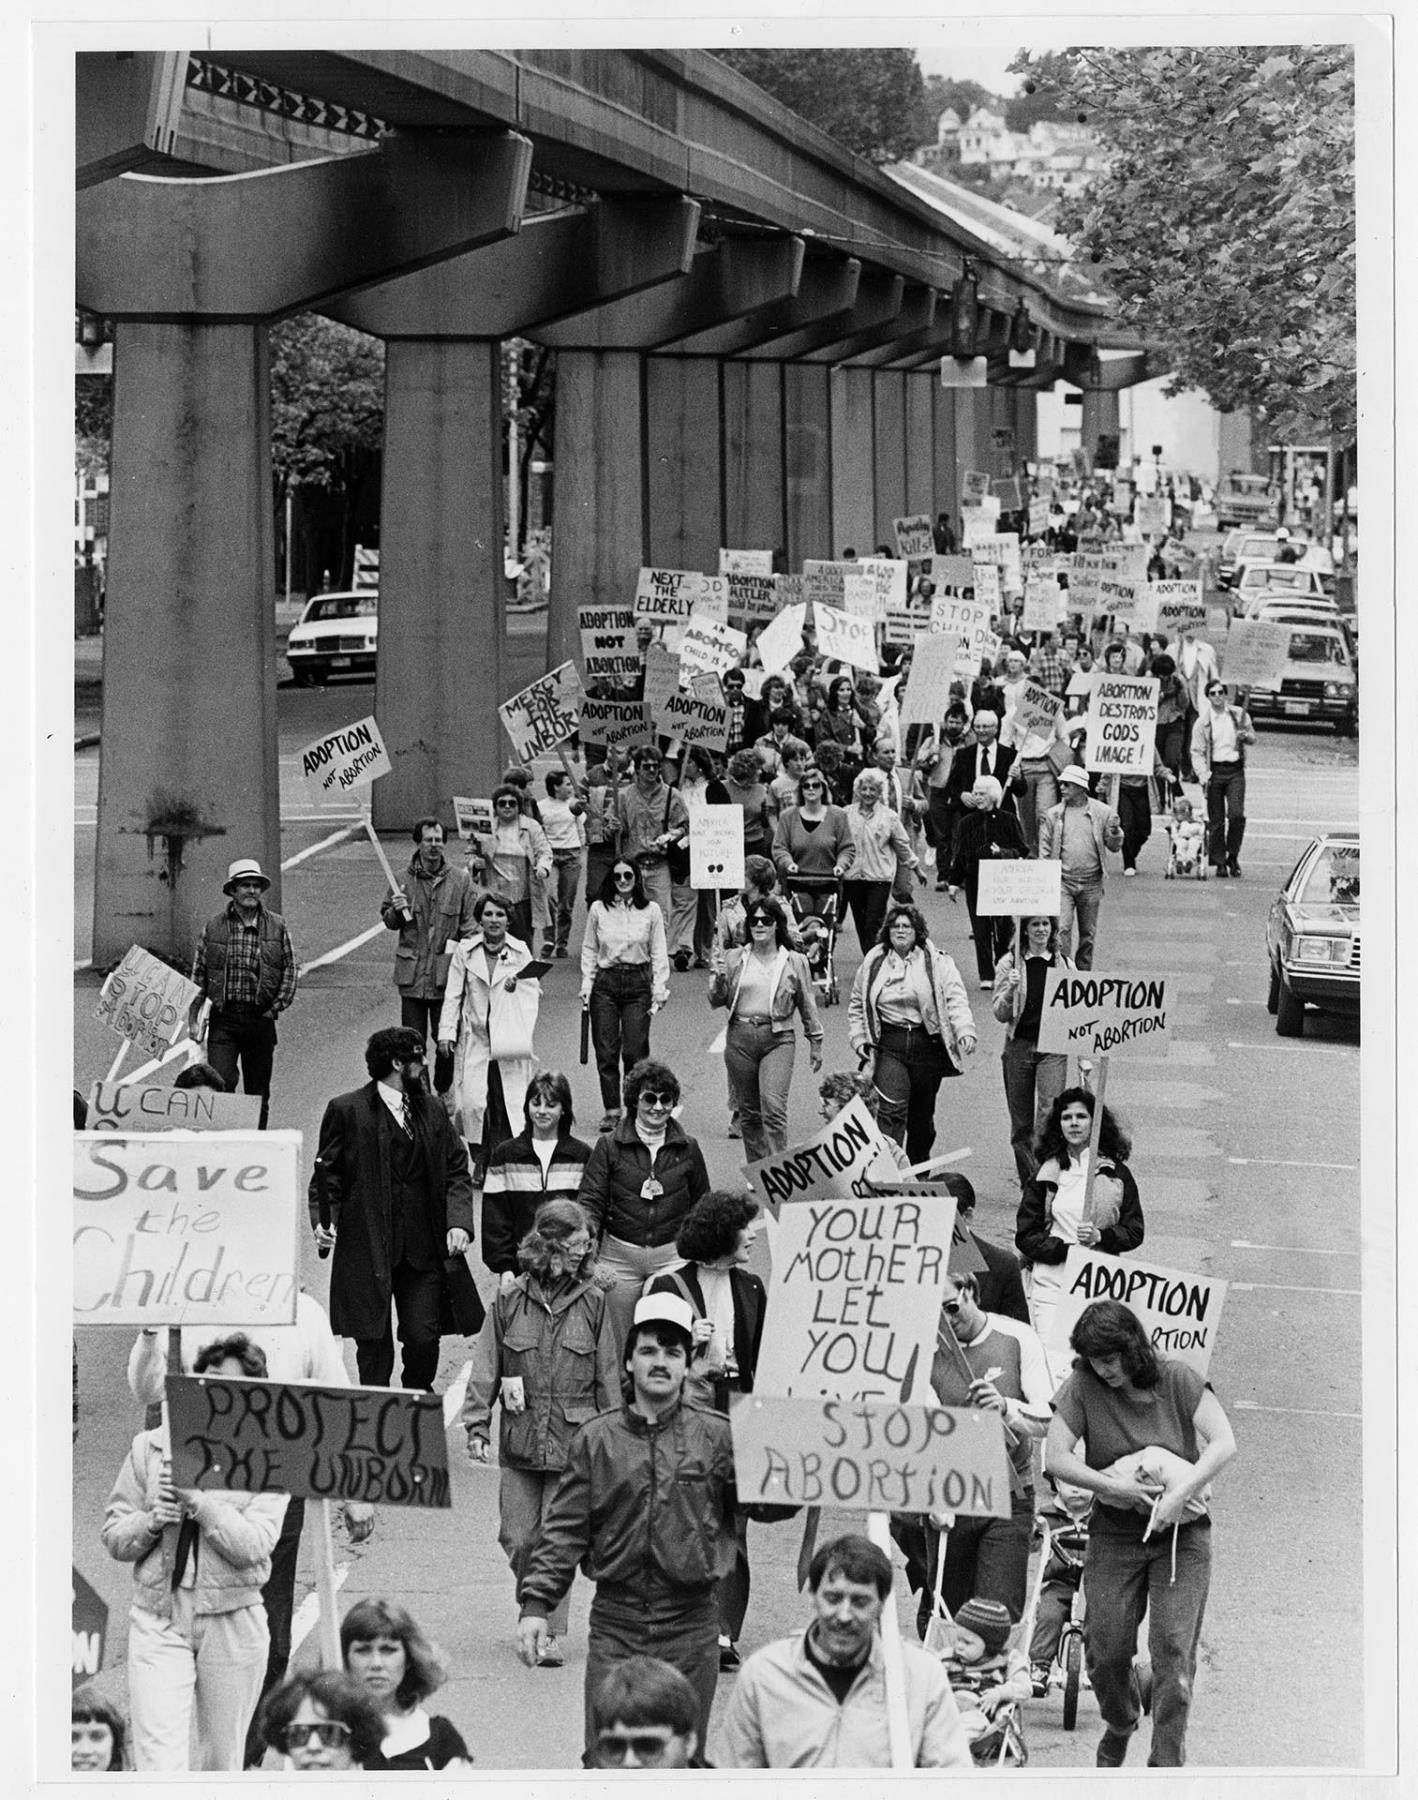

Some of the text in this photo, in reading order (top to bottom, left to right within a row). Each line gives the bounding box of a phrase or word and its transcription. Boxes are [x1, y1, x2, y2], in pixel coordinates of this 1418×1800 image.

[636, 595, 695, 616] ELDERLY
[654, 585, 677, 597] THE
[580, 612, 636, 629] ADOPTION
[820, 605, 872, 639] STOP
[936, 604, 984, 623] STOP
[1159, 605, 1207, 618] ADOPTION
[594, 635, 625, 649] NOT
[684, 628, 740, 658] ABORTED
[712, 624, 727, 635] AN
[586, 655, 641, 675] ABORTION
[684, 645, 708, 661] CHILD
[505, 670, 562, 718] MERCY
[1097, 683, 1153, 700] ABORTION
[581, 702, 643, 721] ADOPTION
[664, 695, 726, 725] ADOPTION
[1099, 703, 1156, 720] DESTROYS
[518, 709, 580, 764] UNBOR
[592, 721, 648, 745] NOT ABORTION
[671, 721, 726, 741] NOT ABORTION
[302, 723, 373, 777] ADOPTION
[322, 742, 382, 790] NOT ABORTION
[108, 974, 178, 1027] STOP
[1050, 978, 1165, 1009] ADOPTION
[1068, 1012, 1166, 1053] NOT ABORTION
[140, 1087, 215, 1121] CAN
[73, 1139, 269, 1200] Save
[760, 1113, 871, 1204] ADOPTION
[135, 1202, 221, 1234] the
[806, 1202, 921, 1248] YOUR
[73, 1226, 295, 1312] Children
[1069, 1261, 1211, 1322] ADOPTION
[1151, 1326, 1208, 1351] RTION
[205, 1383, 444, 1467] PROTECT
[184, 1435, 450, 1508] THE UNBORN
